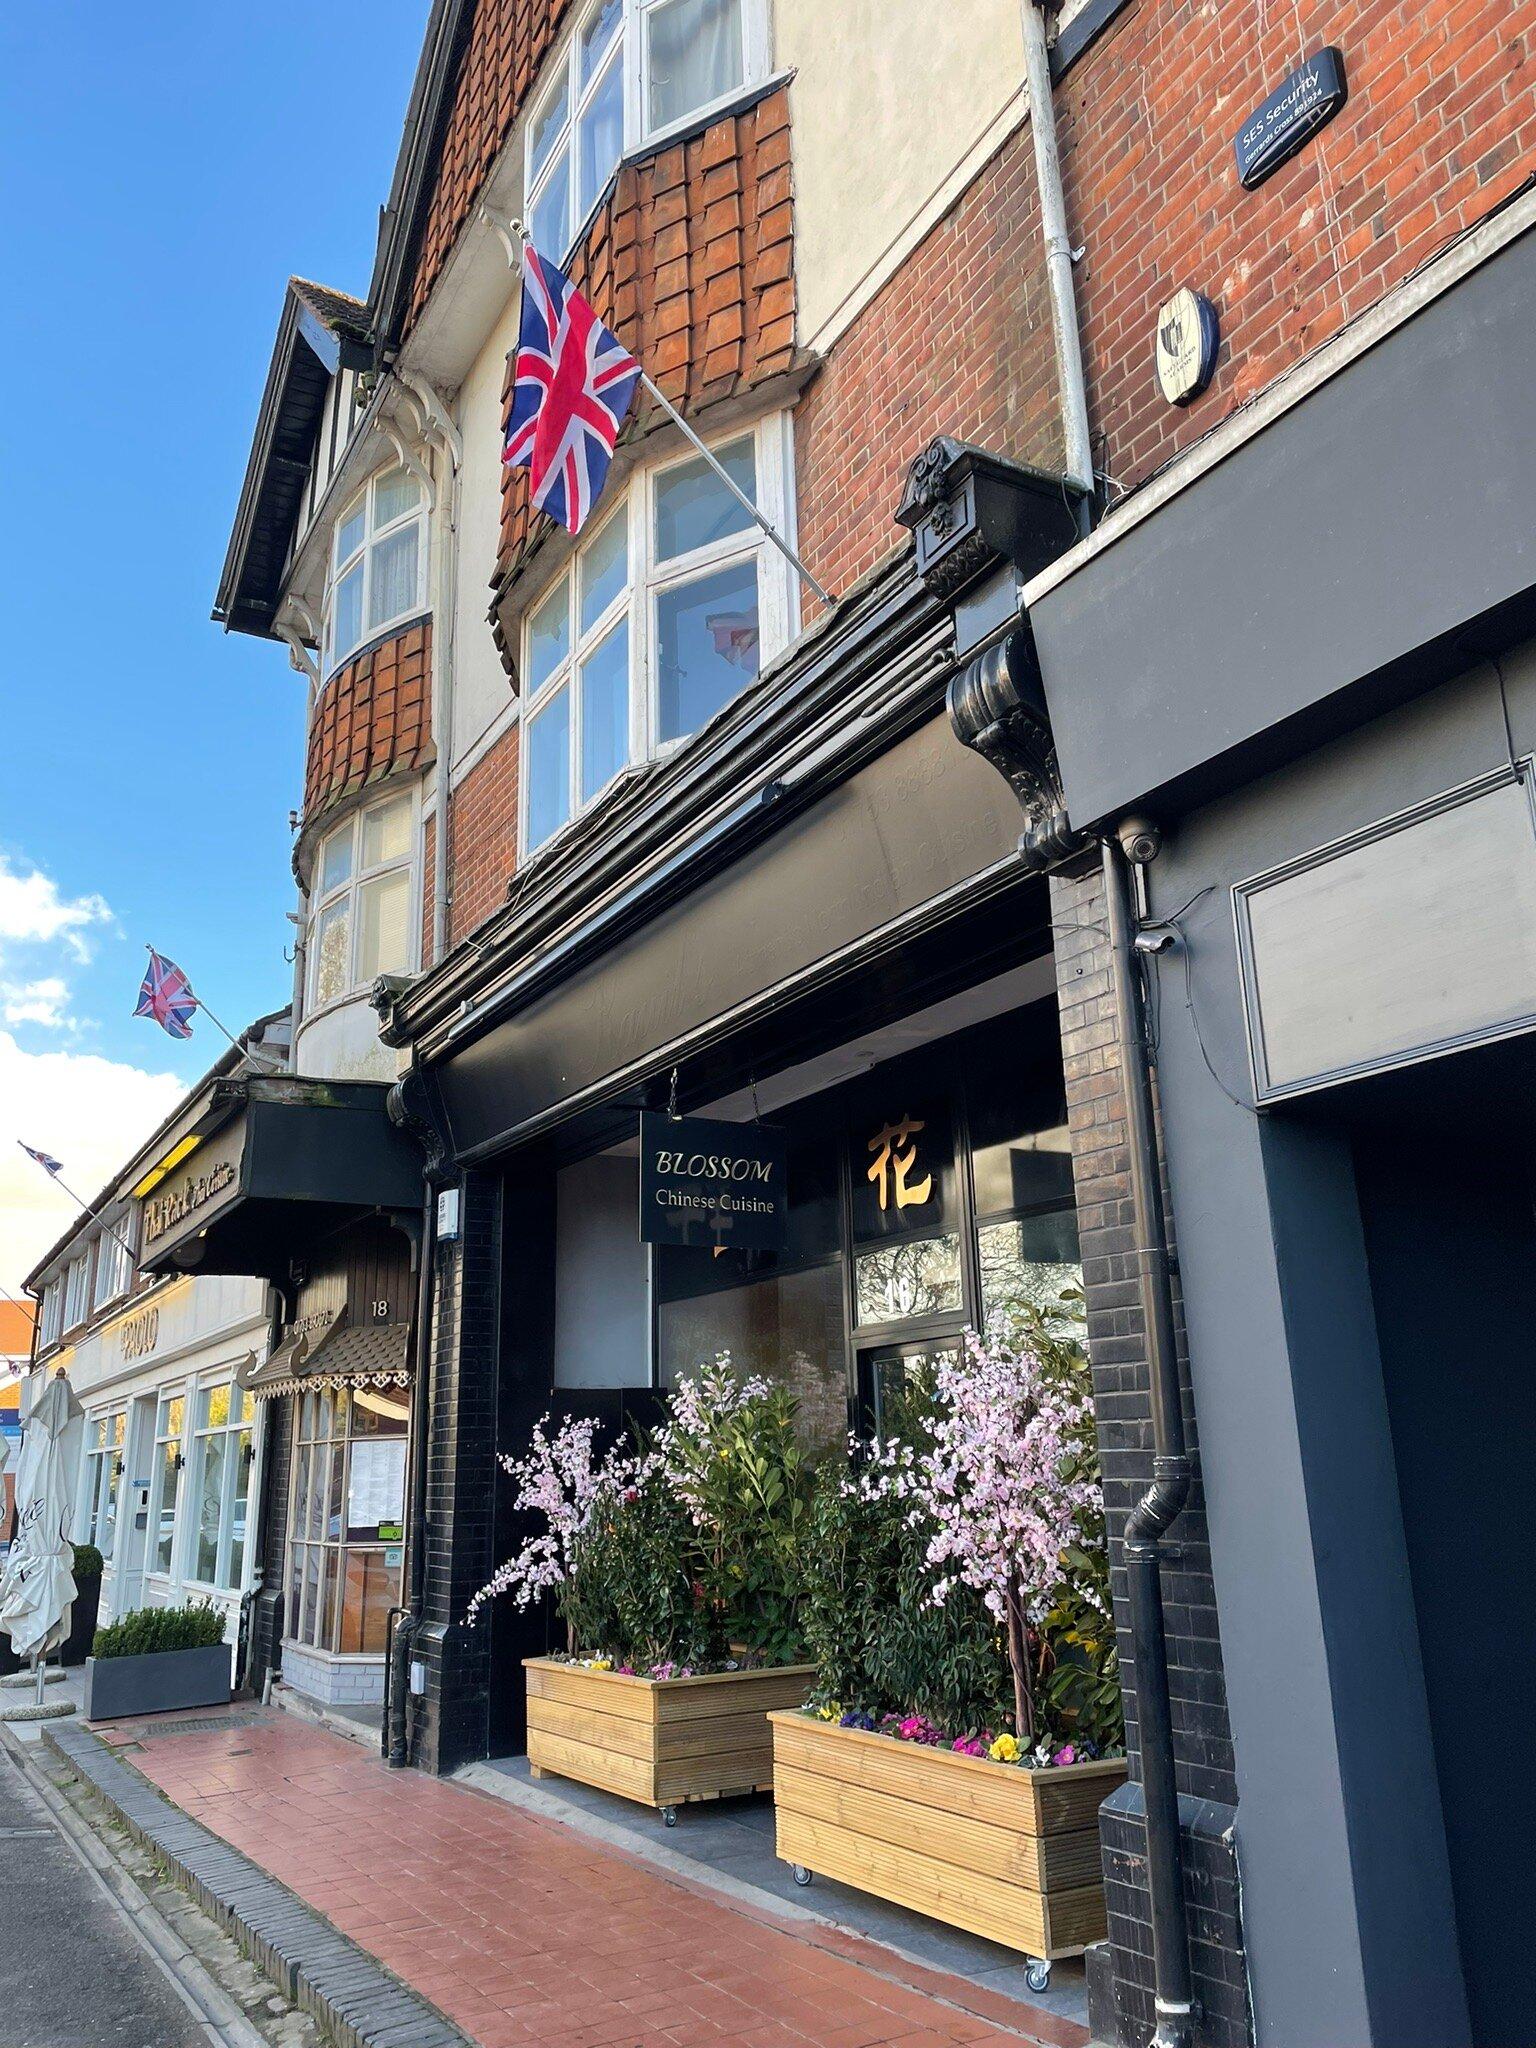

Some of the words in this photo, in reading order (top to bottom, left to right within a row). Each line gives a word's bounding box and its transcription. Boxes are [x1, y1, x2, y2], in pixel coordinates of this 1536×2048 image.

[1242, 120, 1264, 149] SES
[1265, 70, 1319, 125] Security
[1245, 134, 1274, 164] Gerrards
[1274, 114, 1293, 135] Cross
[655, 1151, 773, 1183] BLOSSOM
[866, 1113, 932, 1211] 花
[655, 1189, 715, 1209] Chinese
[719, 1194, 775, 1213] Cuisine
[372, 1300, 388, 1317] 18
[884, 1277, 911, 1314] 16
